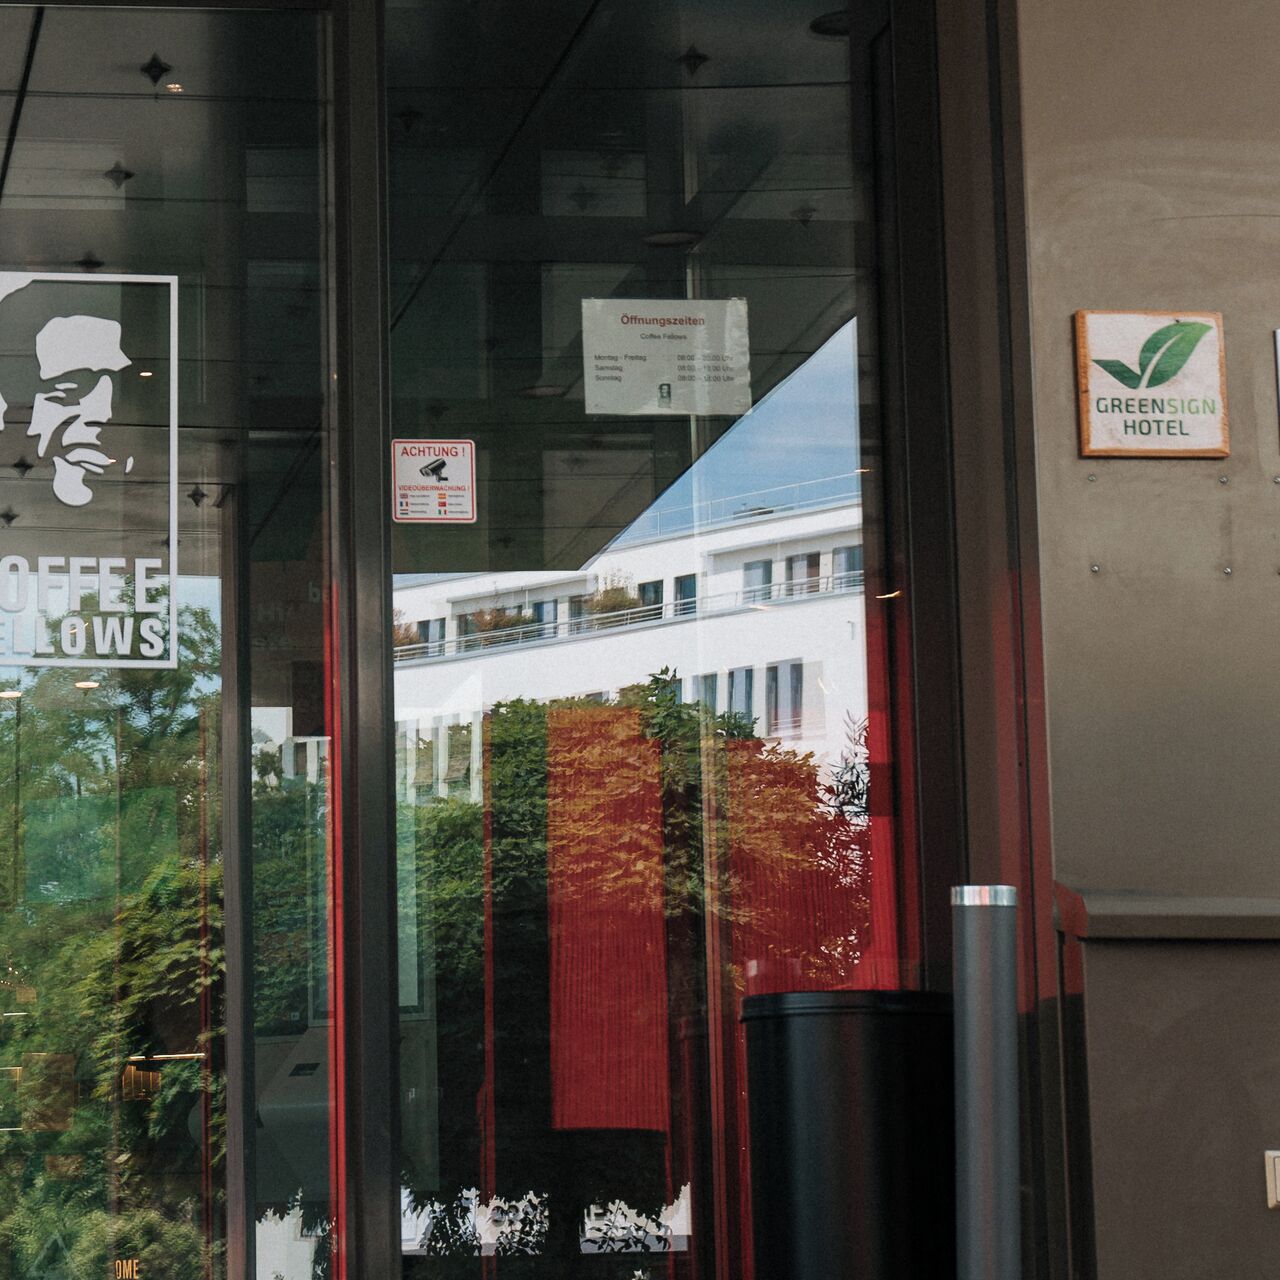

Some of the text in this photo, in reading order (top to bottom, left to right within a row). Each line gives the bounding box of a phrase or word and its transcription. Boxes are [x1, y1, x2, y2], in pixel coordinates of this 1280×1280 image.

[620, 313, 705, 327] Öffnungszeiten
[594, 354, 618, 362] Montag
[624, 354, 647, 362] Freitag
[594, 364, 623, 372] Samstag
[595, 374, 622, 382] Sonntag
[1096, 397, 1216, 415] GREENSIGN
[1124, 419, 1190, 436] HOTEL
[401, 446, 459, 457] ACHTUNG
